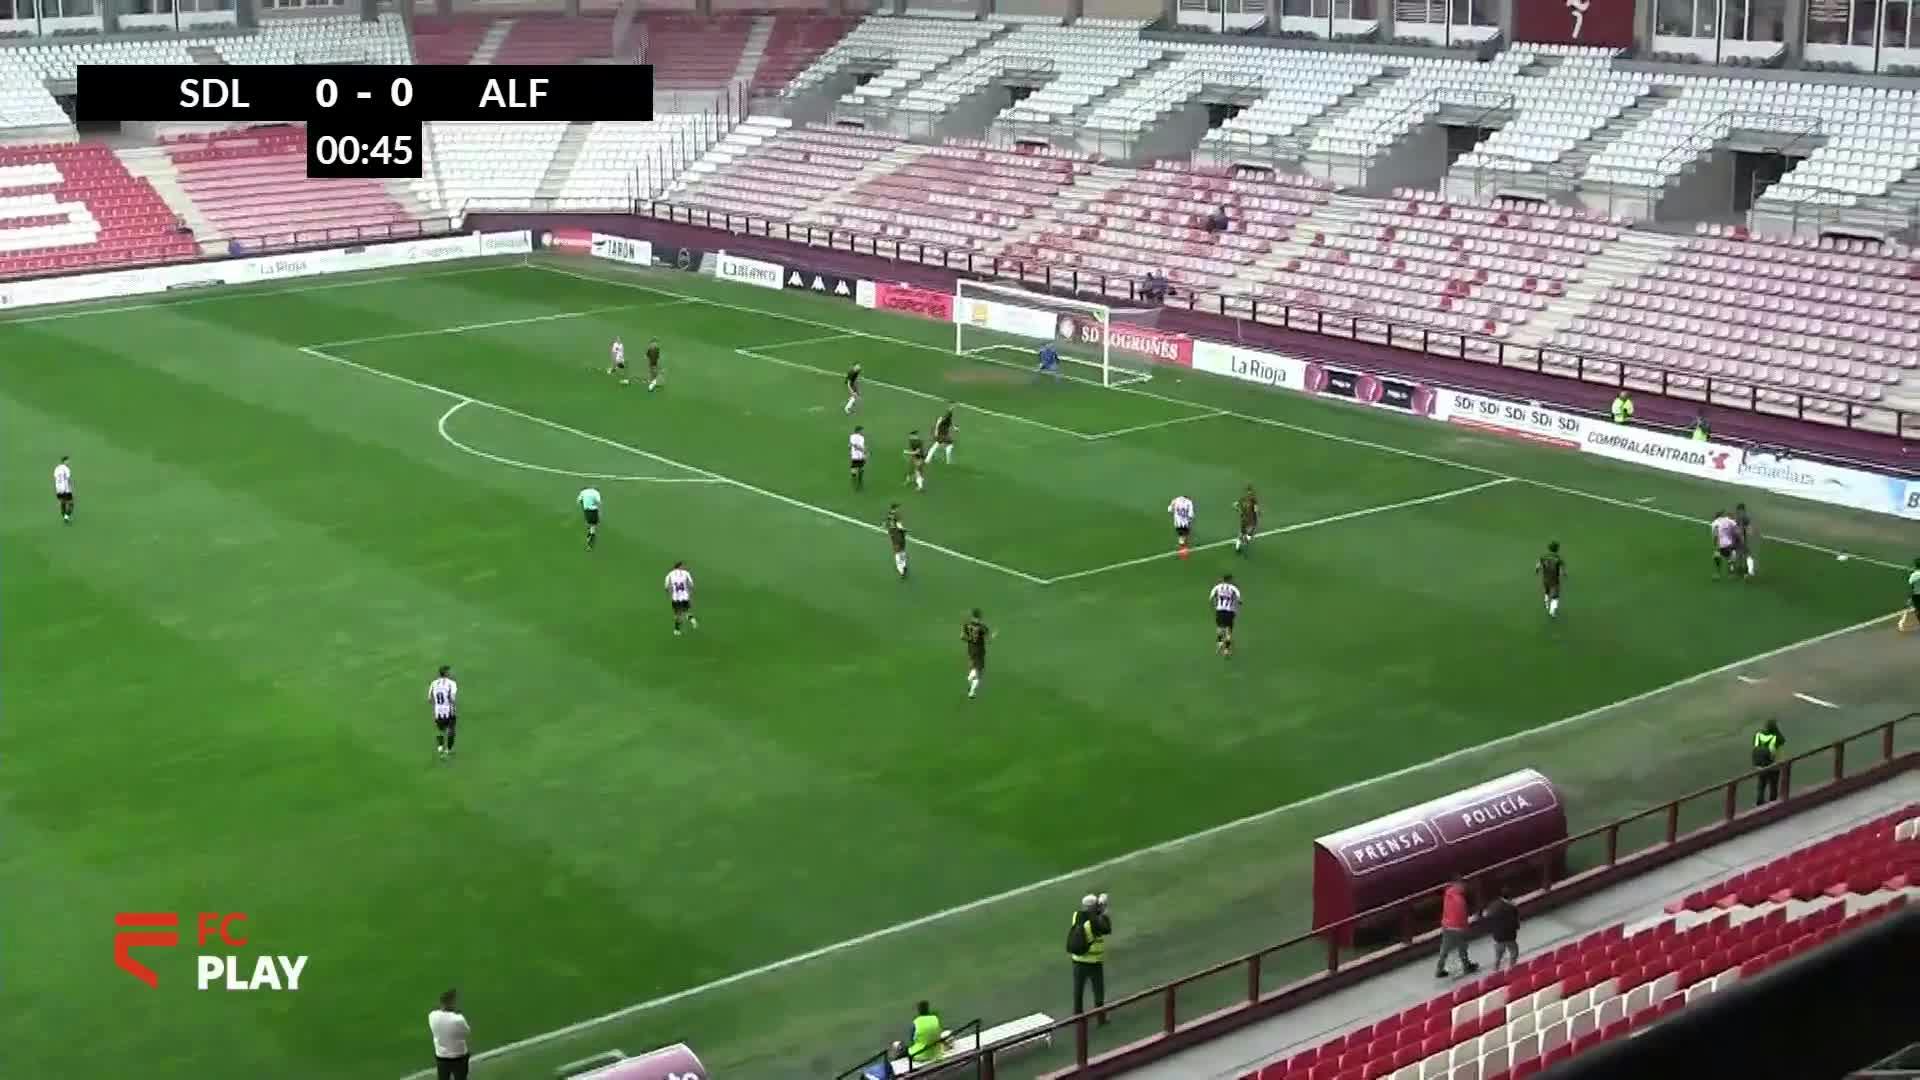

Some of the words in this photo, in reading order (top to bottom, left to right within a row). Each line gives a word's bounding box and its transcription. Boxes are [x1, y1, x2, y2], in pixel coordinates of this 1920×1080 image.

[1081, 325, 1099, 343] SD
[1231, 355, 1247, 375] La
[1250, 359, 1286, 386] Rioja
[1461, 794, 1531, 828] POLICÍA
[1353, 830, 1425, 863] PRENSA
